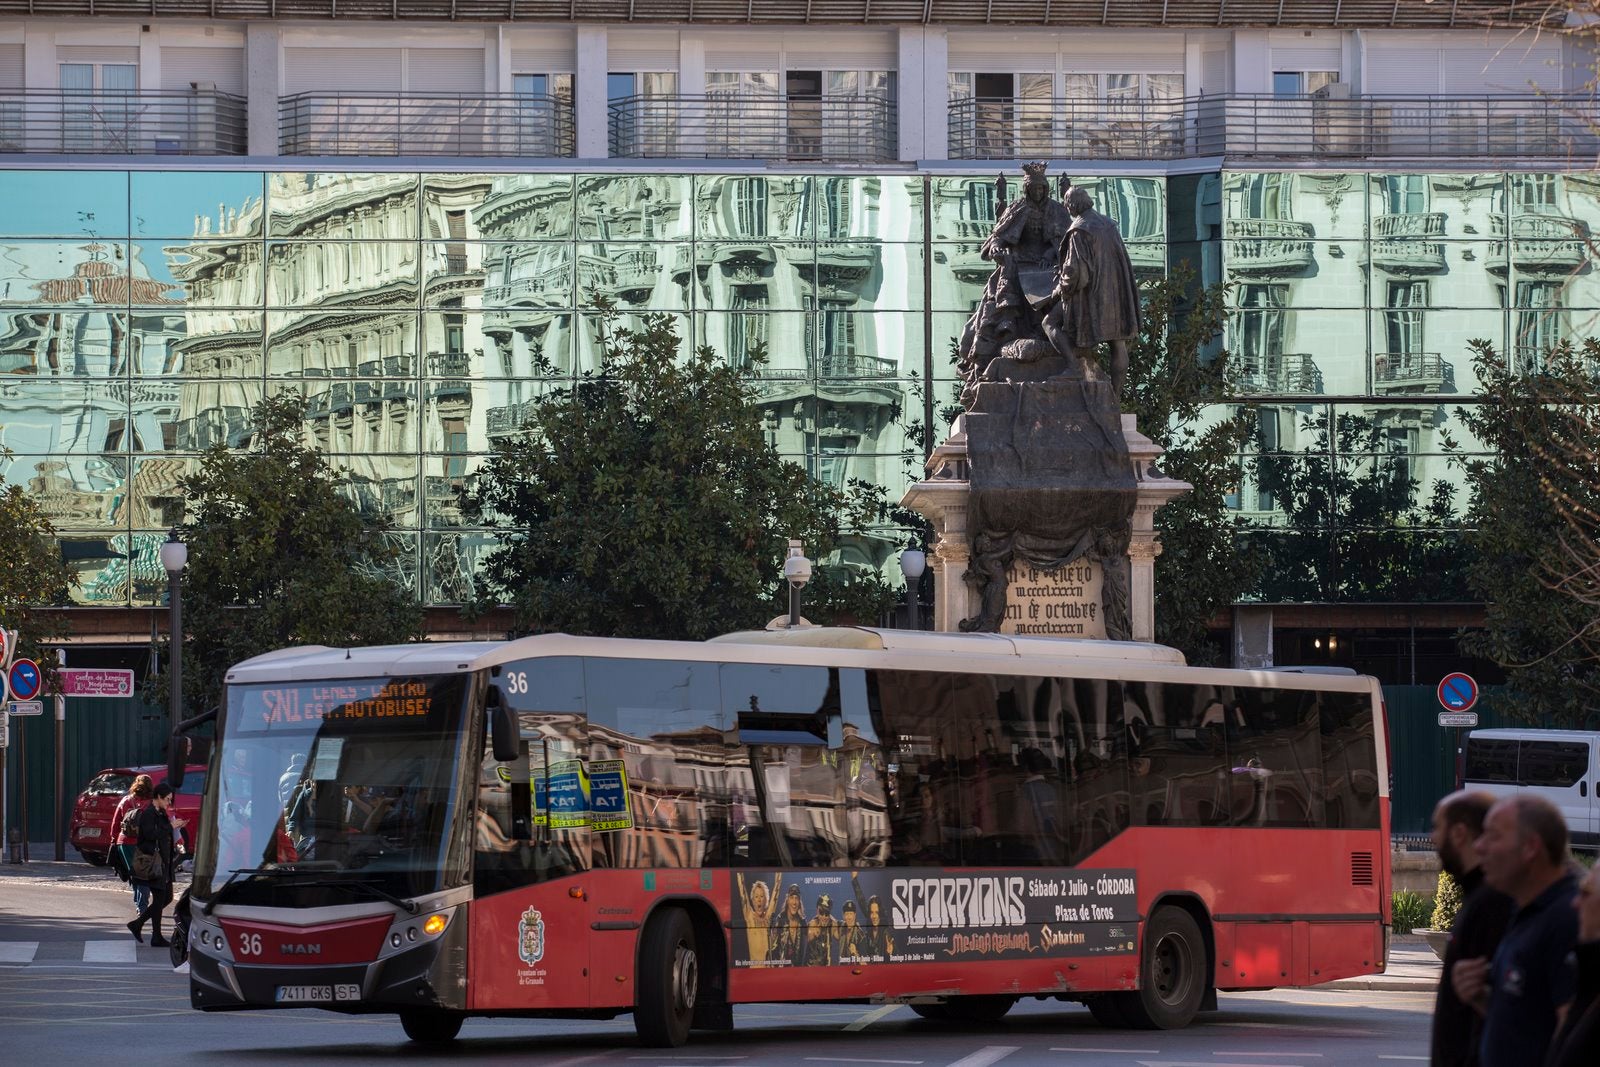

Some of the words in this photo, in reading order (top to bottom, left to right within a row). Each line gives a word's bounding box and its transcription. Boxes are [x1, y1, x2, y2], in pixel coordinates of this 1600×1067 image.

[507, 671, 528, 694] 36
[1029, 878, 1059, 897] Sábado
[1061, 879, 1066, 896] 2
[1068, 878, 1088, 896] Julio
[1096, 873, 1135, 895] CÓRDOBA
[892, 876, 1026, 929] SCORPIONS
[1055, 904, 1078, 921] Plaza
[1079, 903, 1090, 920] de
[1091, 903, 1114, 920] Toros
[240, 932, 262, 955] 36
[280, 943, 321, 954] MAN
[1041, 923, 1085, 953] Sabaton
[281, 985, 307, 1000] 7411
[310, 985, 332, 1000] GKS
